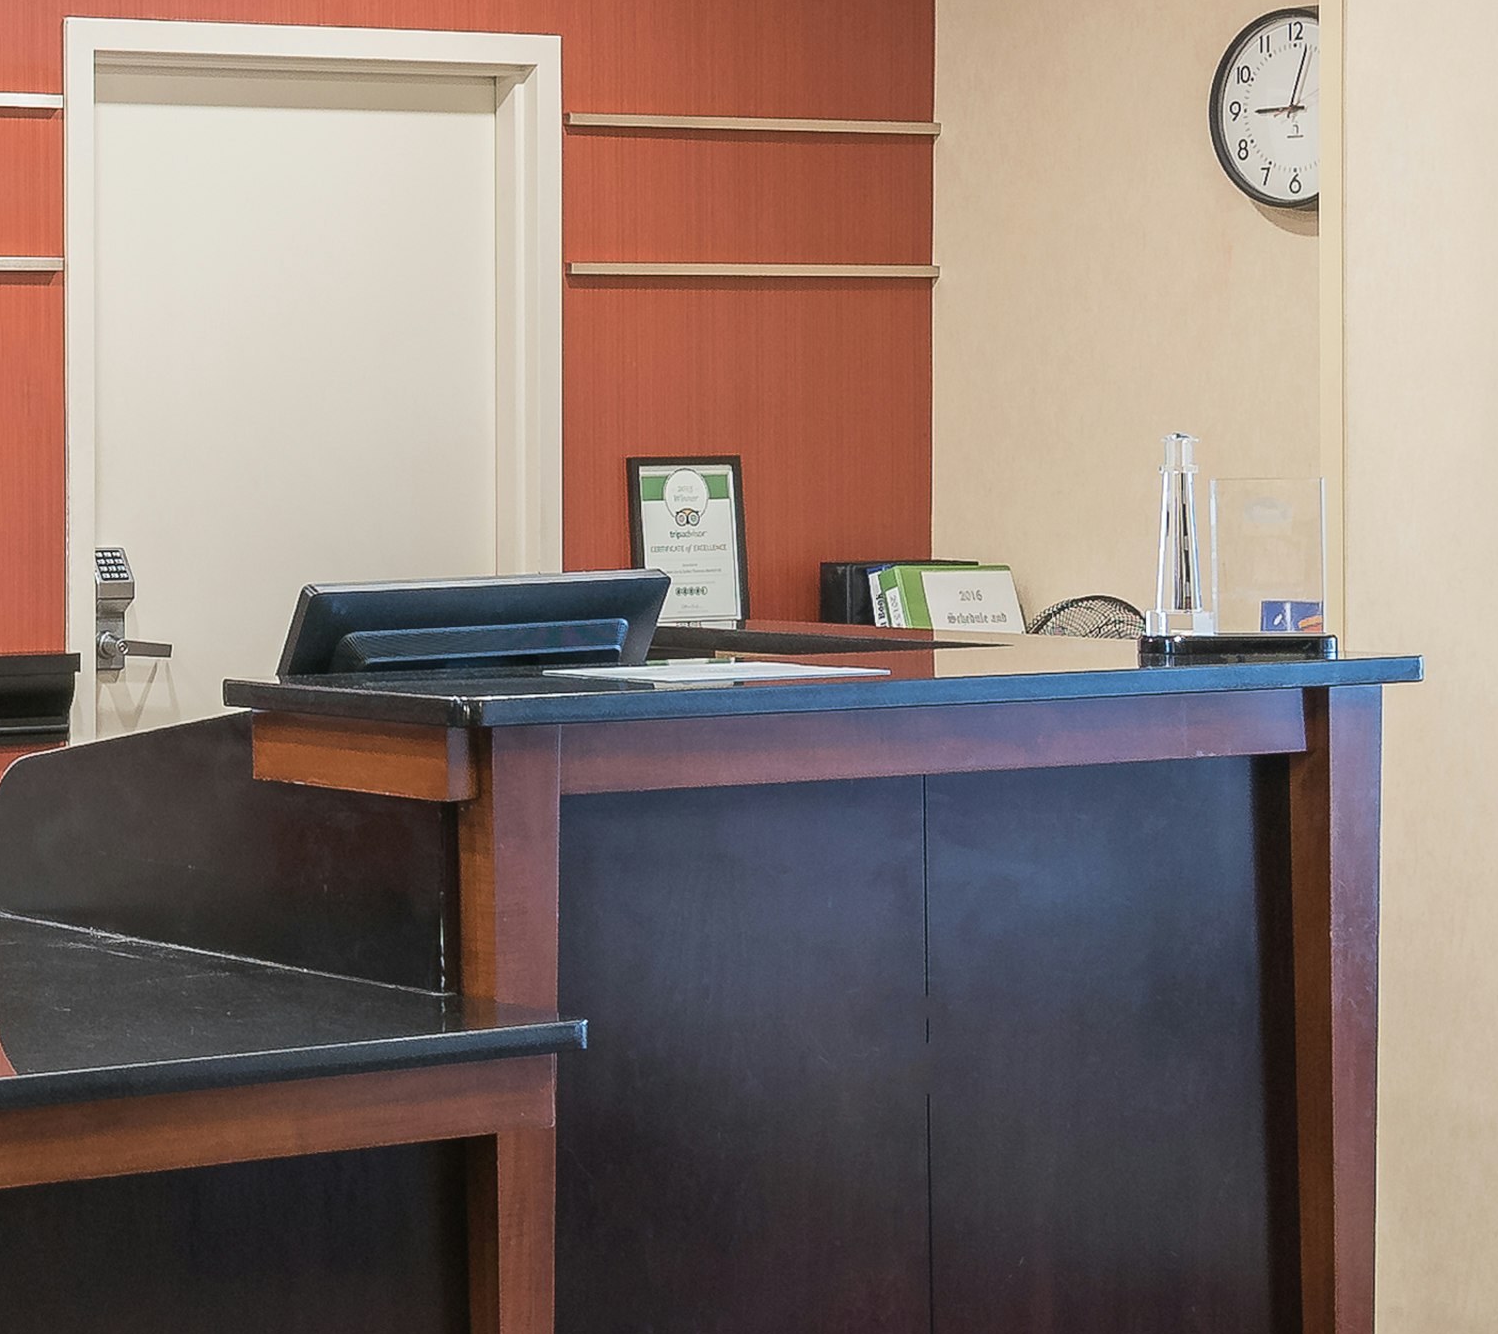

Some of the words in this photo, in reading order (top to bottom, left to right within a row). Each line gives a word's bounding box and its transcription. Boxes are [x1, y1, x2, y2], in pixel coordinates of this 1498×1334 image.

[1288, 21, 1304, 41] 12
[1259, 34, 1271, 54] 11
[1236, 65, 1251, 85] 10
[1229, 101, 1242, 122] 9
[1237, 139, 1249, 161] 8
[1260, 166, 1271, 186] 7
[1289, 173, 1302, 195] 6
[958, 590, 984, 602] 2016
[947, 612, 989, 626] Schedule
[990, 612, 1008, 624] and
